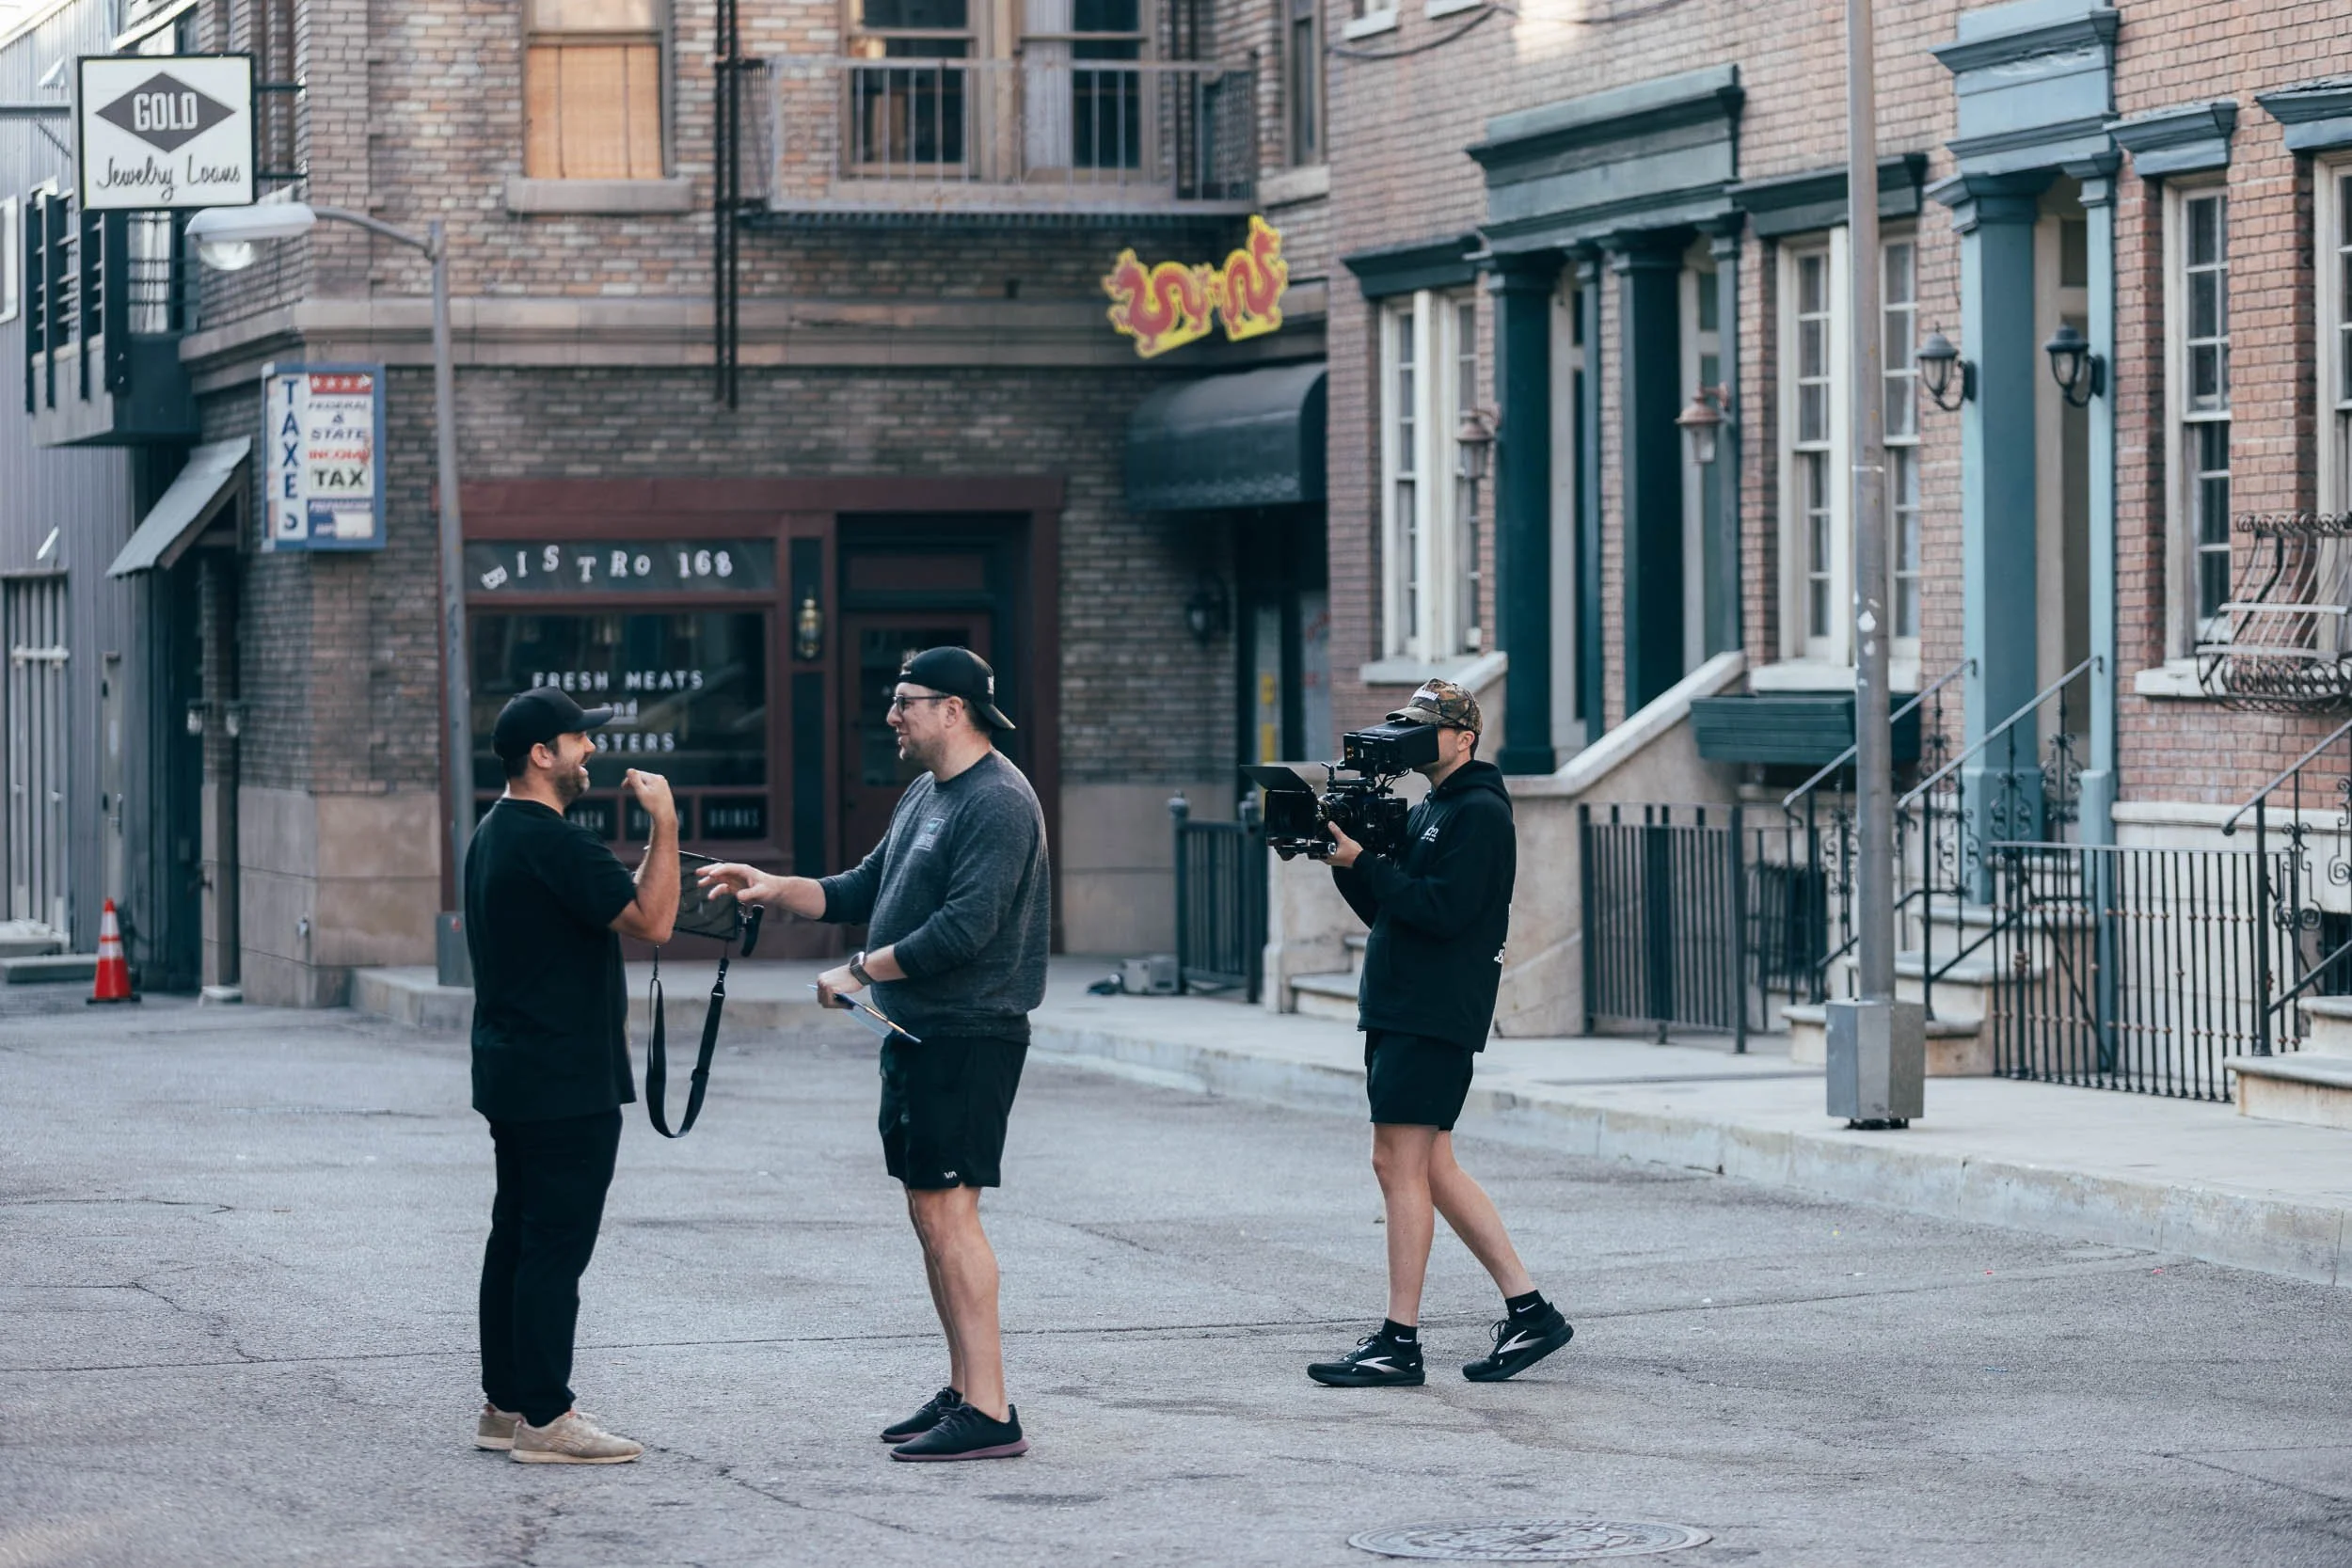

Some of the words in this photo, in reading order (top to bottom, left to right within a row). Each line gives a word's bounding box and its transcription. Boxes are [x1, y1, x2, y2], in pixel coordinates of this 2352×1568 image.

[133, 92, 199, 132] GOLD
[96, 155, 177, 201] Jewelry
[186, 154, 241, 185] Loans
[310, 428, 366, 440] STATE
[313, 468, 365, 486] TAX
[480, 545, 651, 590] BISTRO
[677, 549, 733, 578] 168
[532, 671, 609, 691] FRESH
[625, 670, 704, 690] MEATS
[595, 733, 675, 752] STERS
